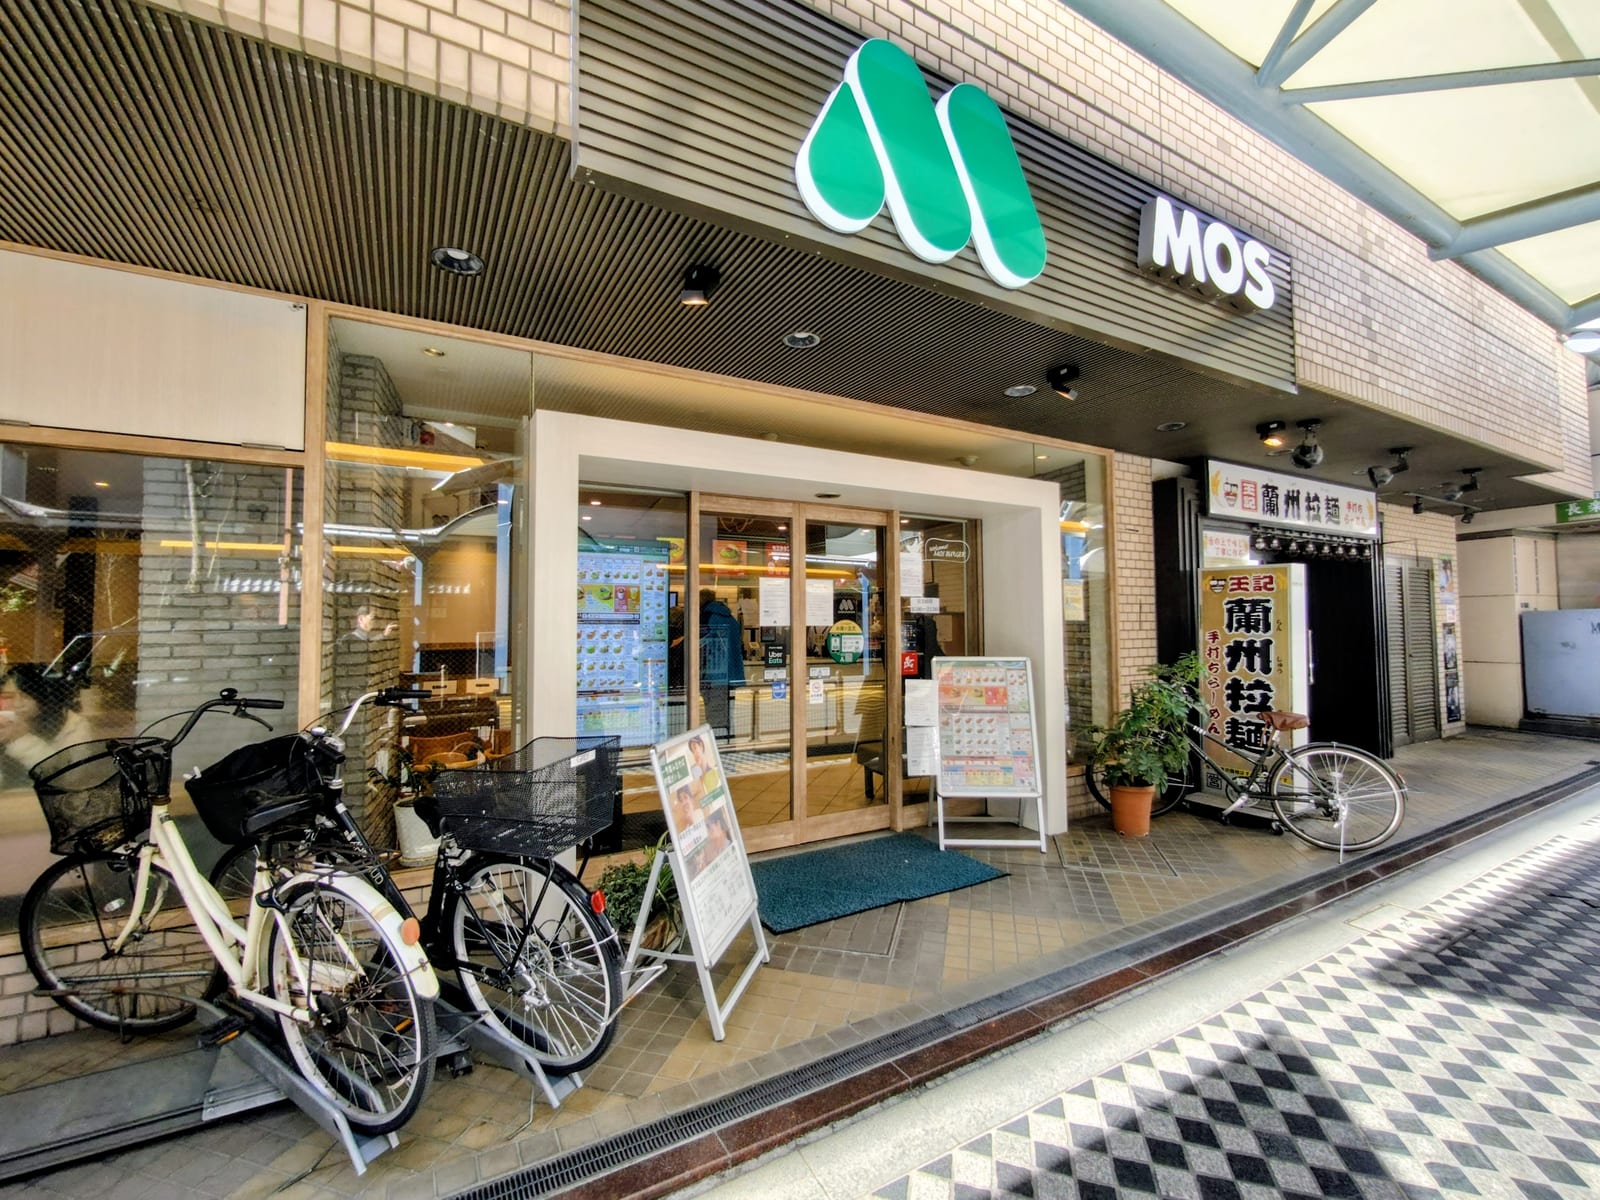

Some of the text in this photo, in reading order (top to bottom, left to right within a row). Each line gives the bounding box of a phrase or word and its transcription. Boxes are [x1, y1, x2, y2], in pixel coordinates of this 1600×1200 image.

[1152, 196, 1275, 310] MOS
[1228, 575, 1275, 593] 王記
[1206, 630, 1221, 736] 手打ちらーめん
[1224, 597, 1274, 757] 蘭州拉麺
